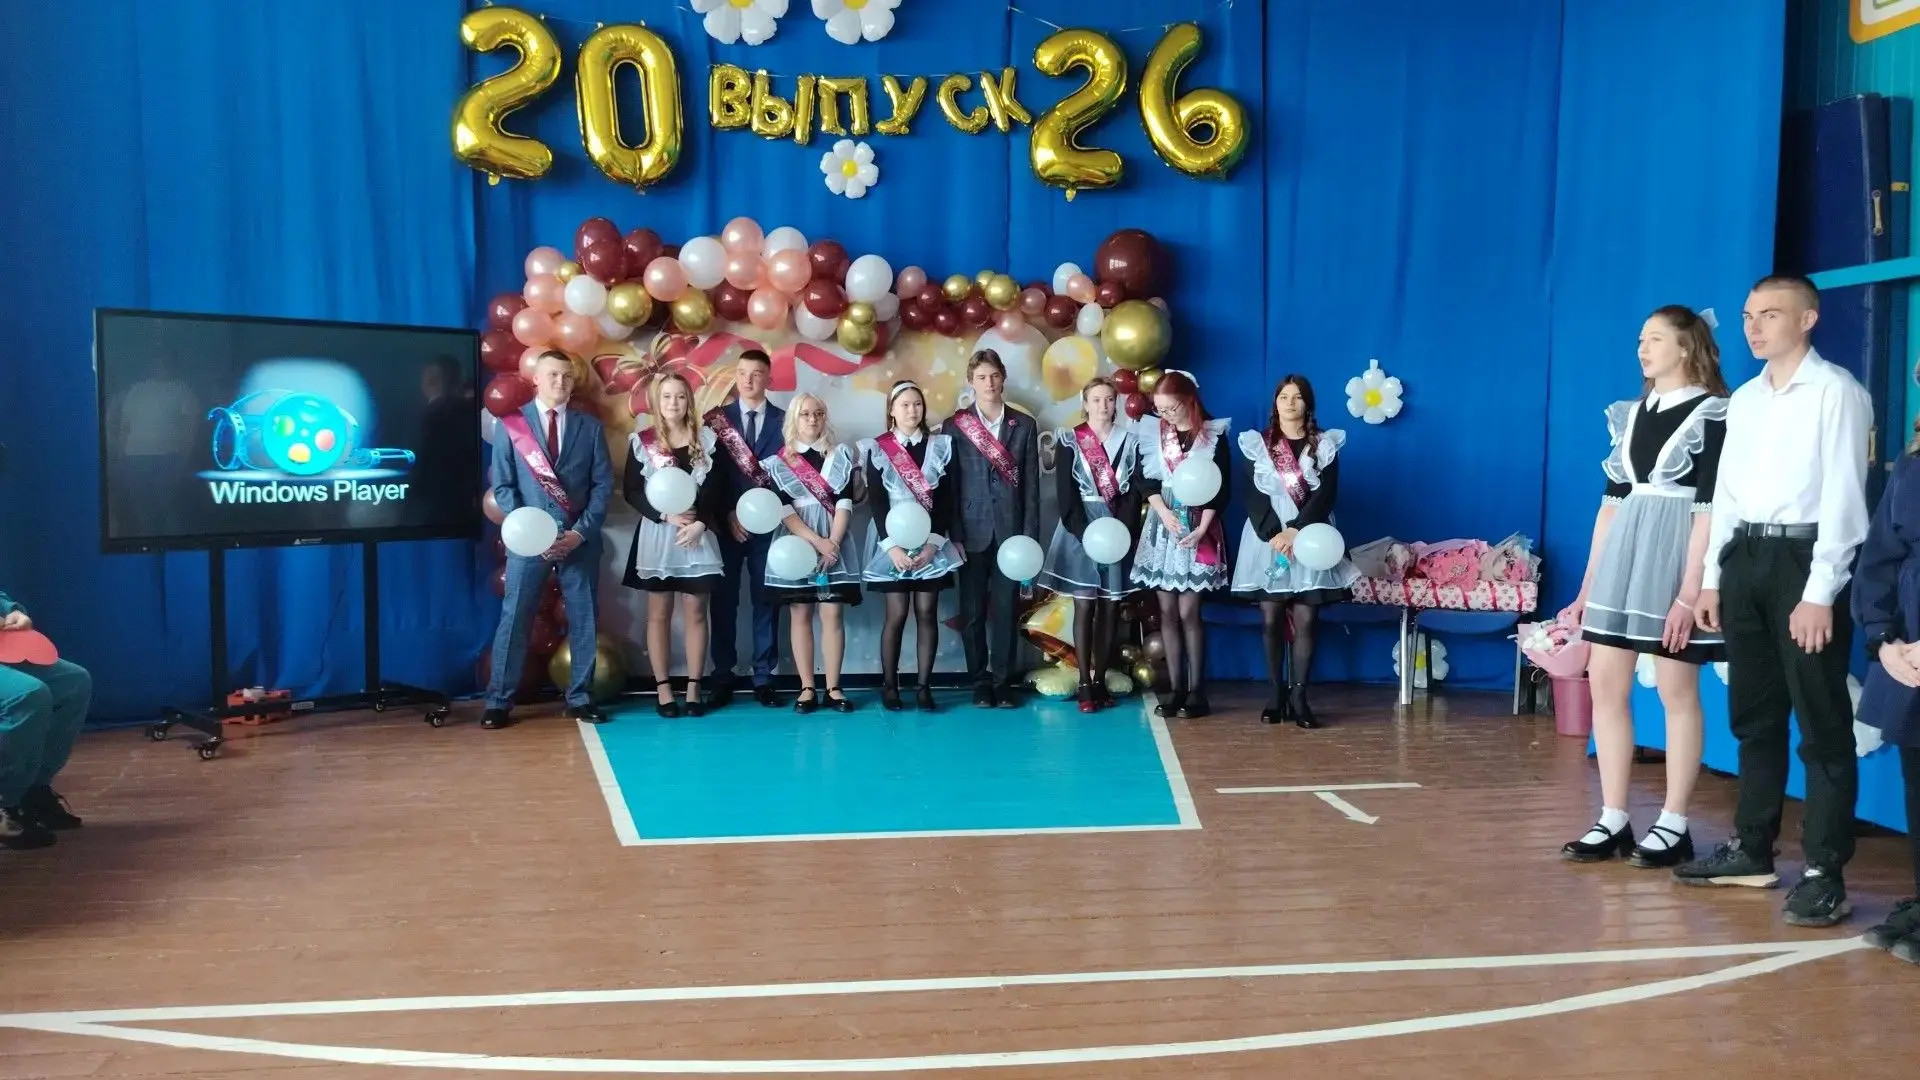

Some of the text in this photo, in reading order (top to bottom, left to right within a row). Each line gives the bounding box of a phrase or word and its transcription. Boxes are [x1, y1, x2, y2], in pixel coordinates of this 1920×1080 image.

[453, 7, 1250, 198] 20 ВЫПУСК 26
[210, 480, 409, 505] Windows Player
